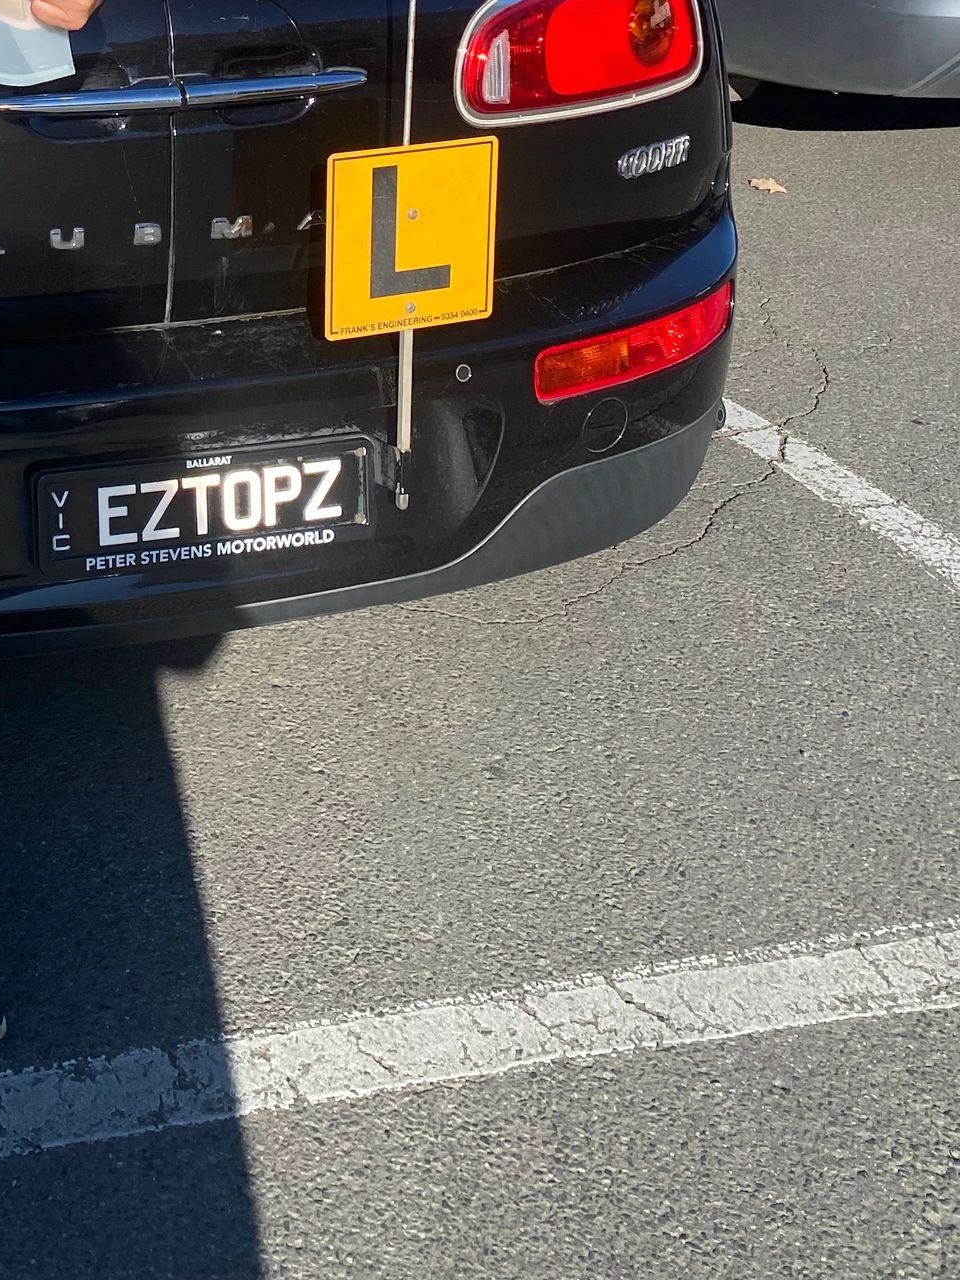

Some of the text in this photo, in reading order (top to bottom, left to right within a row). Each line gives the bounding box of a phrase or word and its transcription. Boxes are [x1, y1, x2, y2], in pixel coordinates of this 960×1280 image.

[369, 164, 451, 298] L
[340, 322, 376, 336] FRANK'S
[377, 315, 433, 330] ENGINEERING
[186, 455, 232, 469] BALLARAT
[97, 459, 342, 547] EZTOPZ
[86, 528, 335, 571] PETER STEVENS MOTORWORLD
